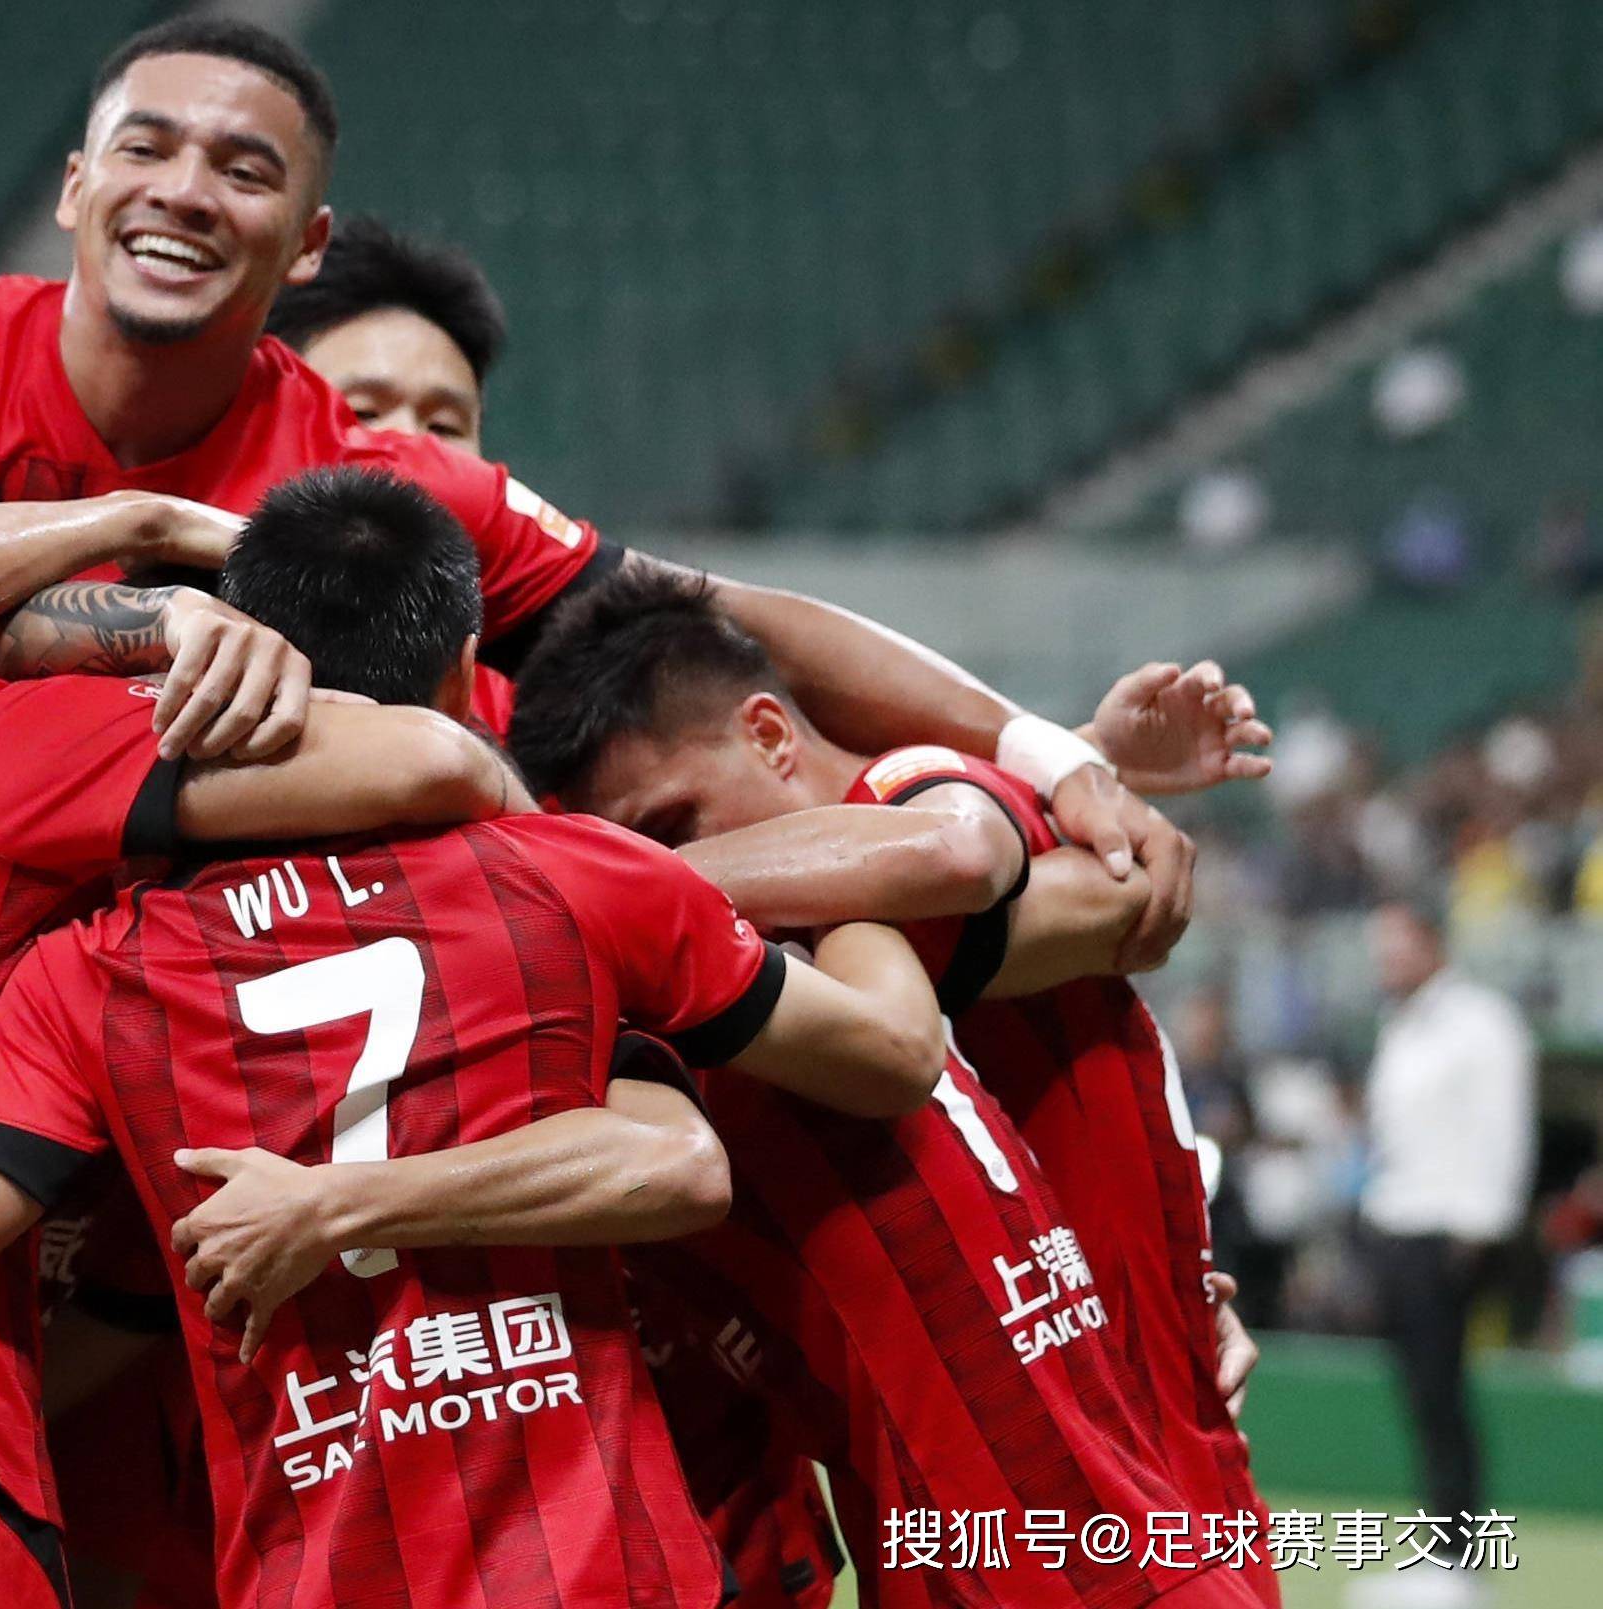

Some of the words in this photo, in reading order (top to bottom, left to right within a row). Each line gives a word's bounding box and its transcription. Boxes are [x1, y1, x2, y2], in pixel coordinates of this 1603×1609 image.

[222, 860, 309, 939] WU
[327, 855, 384, 907] L.
[235, 936, 426, 1278] 7
[992, 1226, 1094, 1328] 上汽集
[273, 1292, 573, 1448] 上汽集团
[1012, 1307, 1082, 1365] SAIC
[379, 1371, 584, 1442] MOTOR
